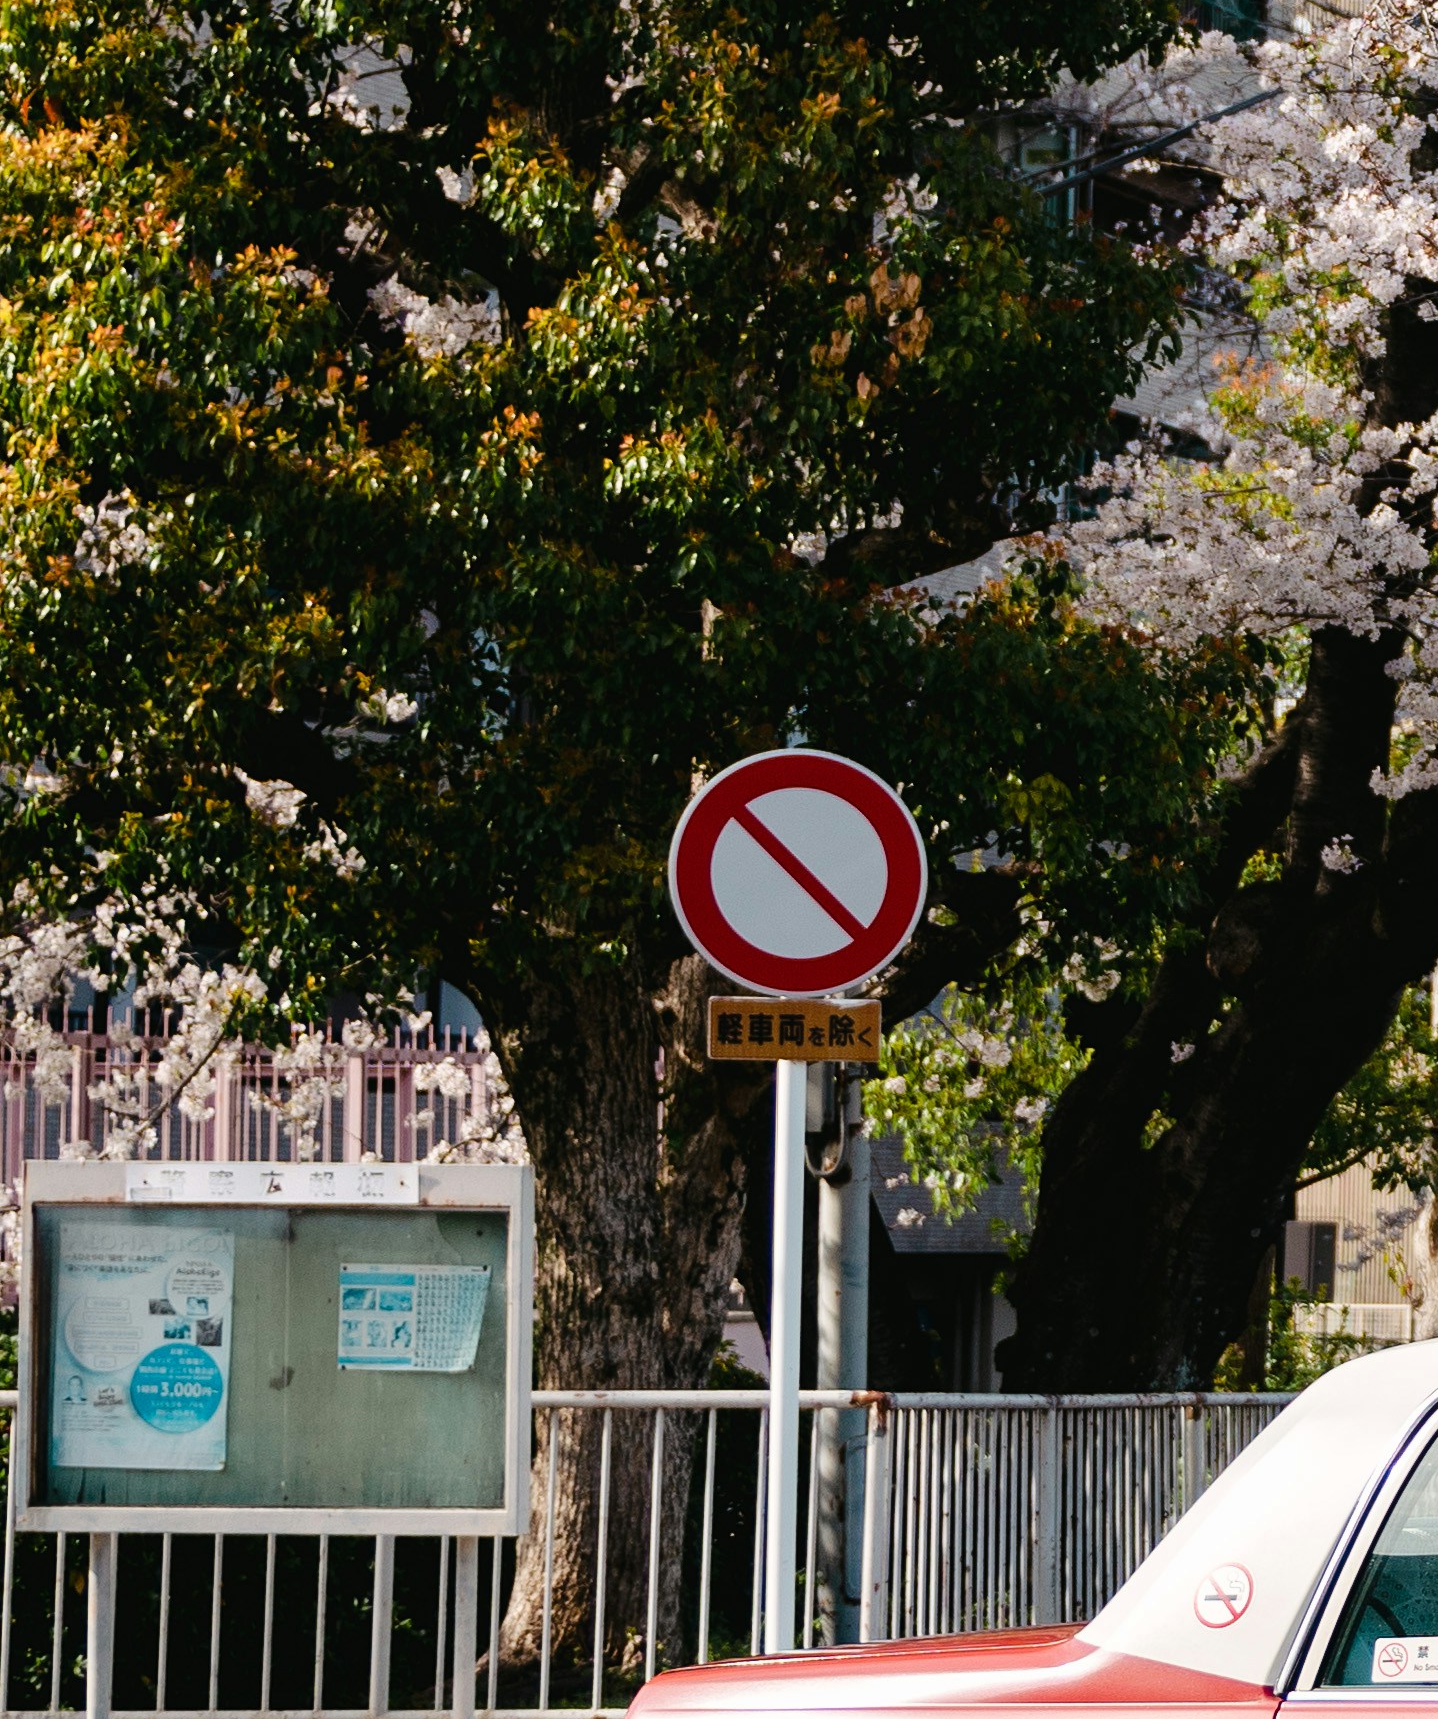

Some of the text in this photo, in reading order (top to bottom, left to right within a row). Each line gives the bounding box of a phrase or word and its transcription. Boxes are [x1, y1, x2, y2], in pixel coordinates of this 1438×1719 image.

[717, 1013, 873, 1048] 軽車両を除く
[1413, 1663, 1423, 1672] No
